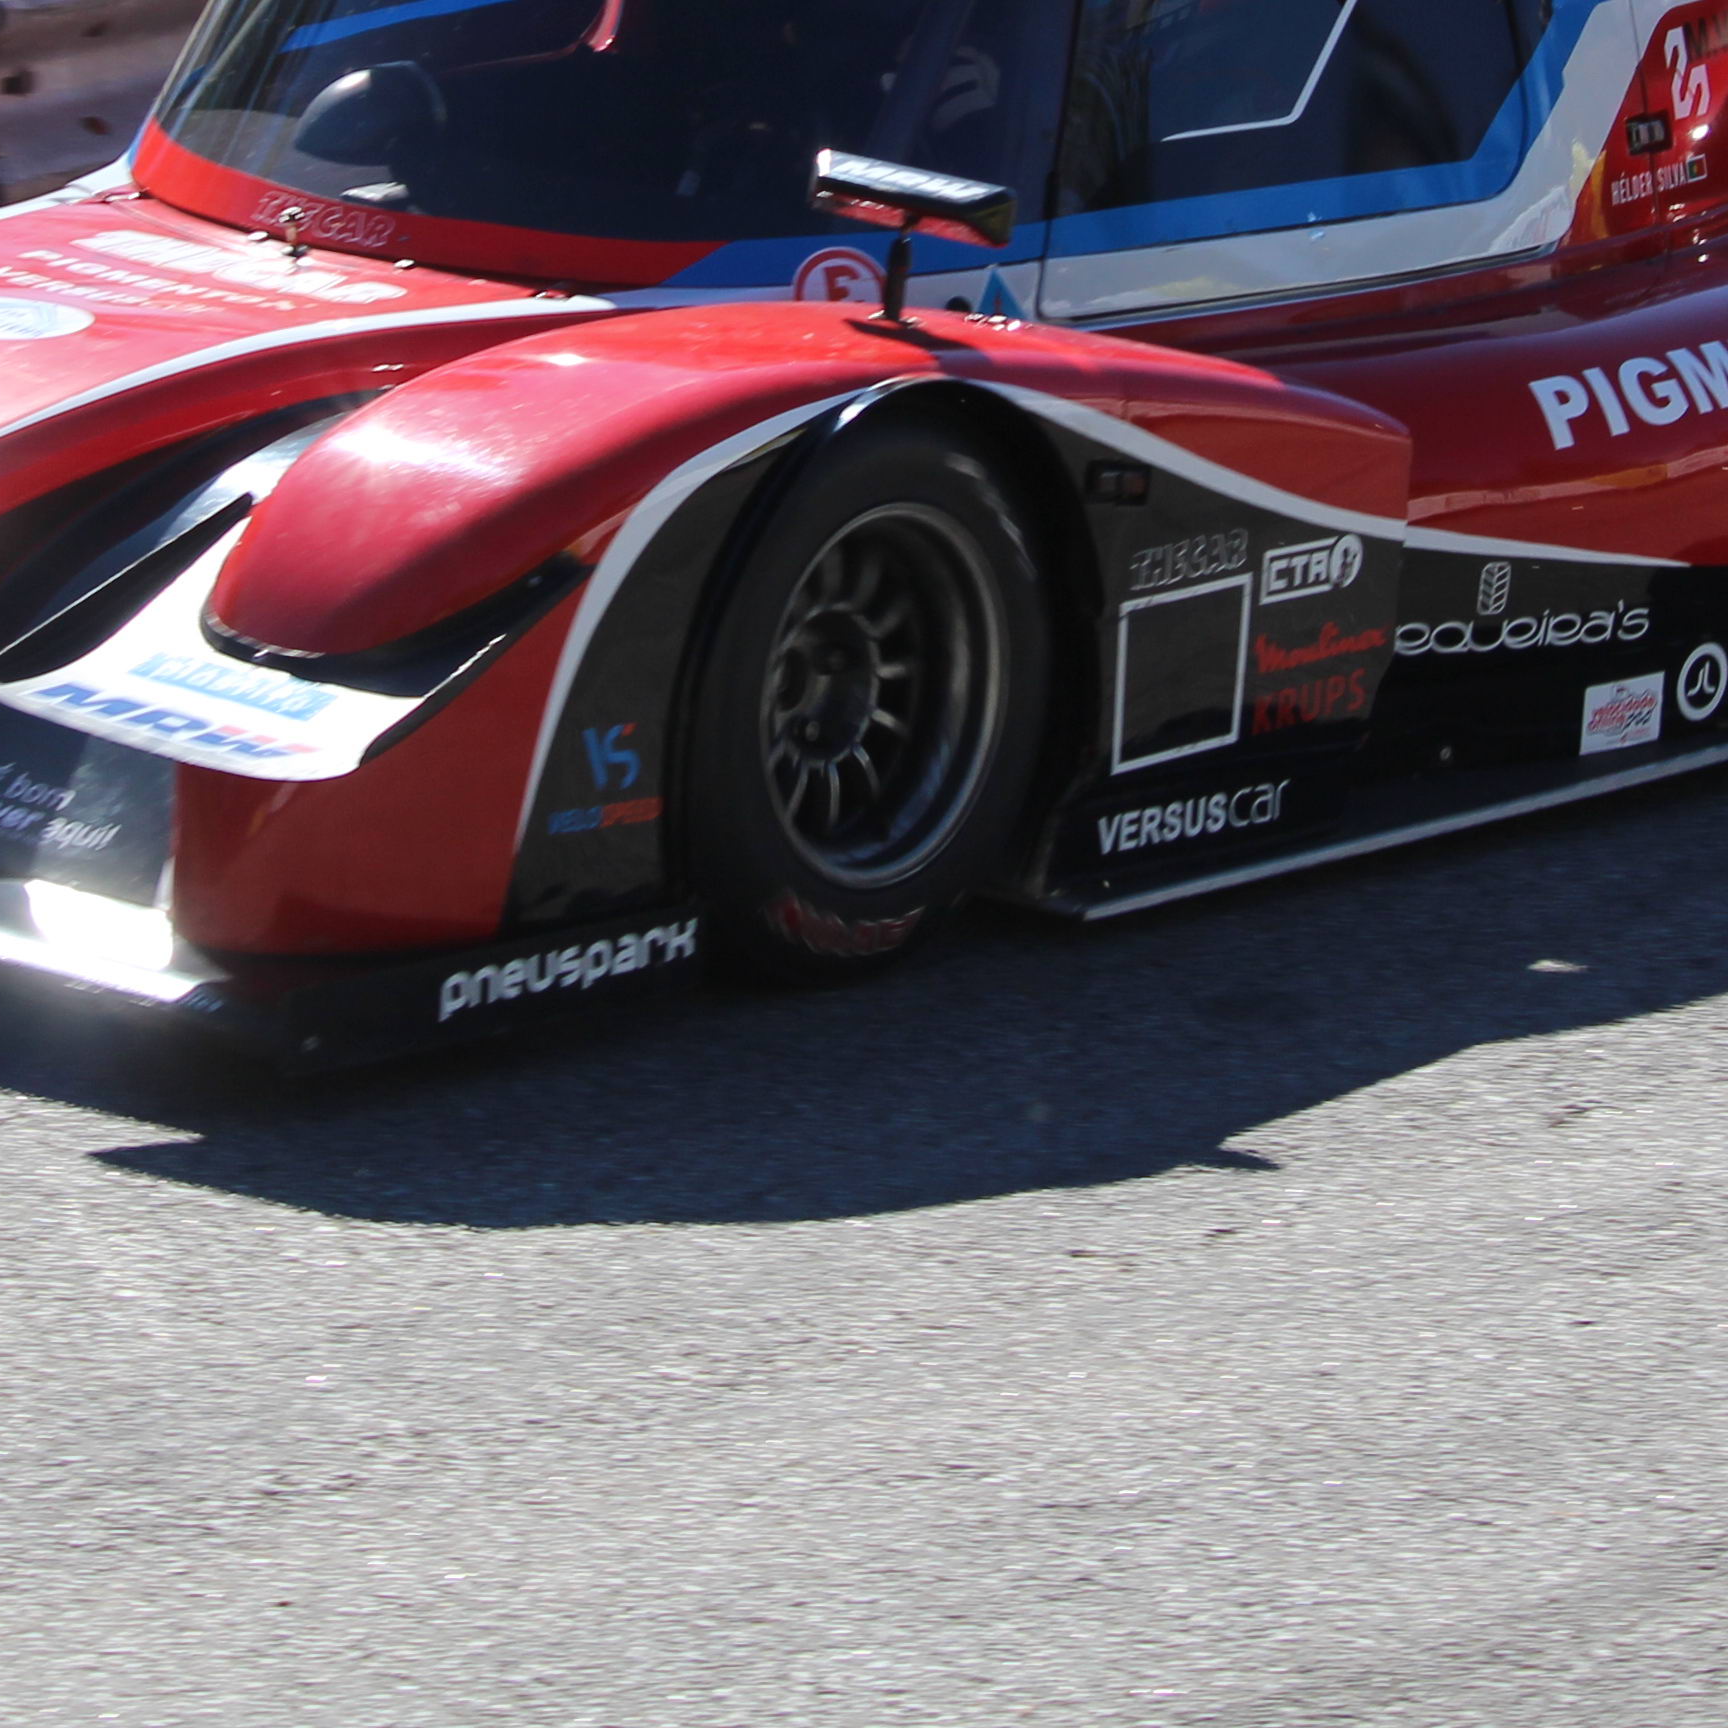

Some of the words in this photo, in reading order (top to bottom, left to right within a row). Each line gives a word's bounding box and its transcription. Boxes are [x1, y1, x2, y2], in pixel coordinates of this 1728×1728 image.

[1611, 170, 1654, 206] HÉLDER
[1656, 160, 1688, 193] SILVA
[1268, 550, 1329, 592] CTA
[1251, 667, 1367, 736] KRUPS
[4, 770, 78, 812] bom
[1095, 776, 1295, 855] VERSUScar
[438, 916, 700, 1023] pneuspark
